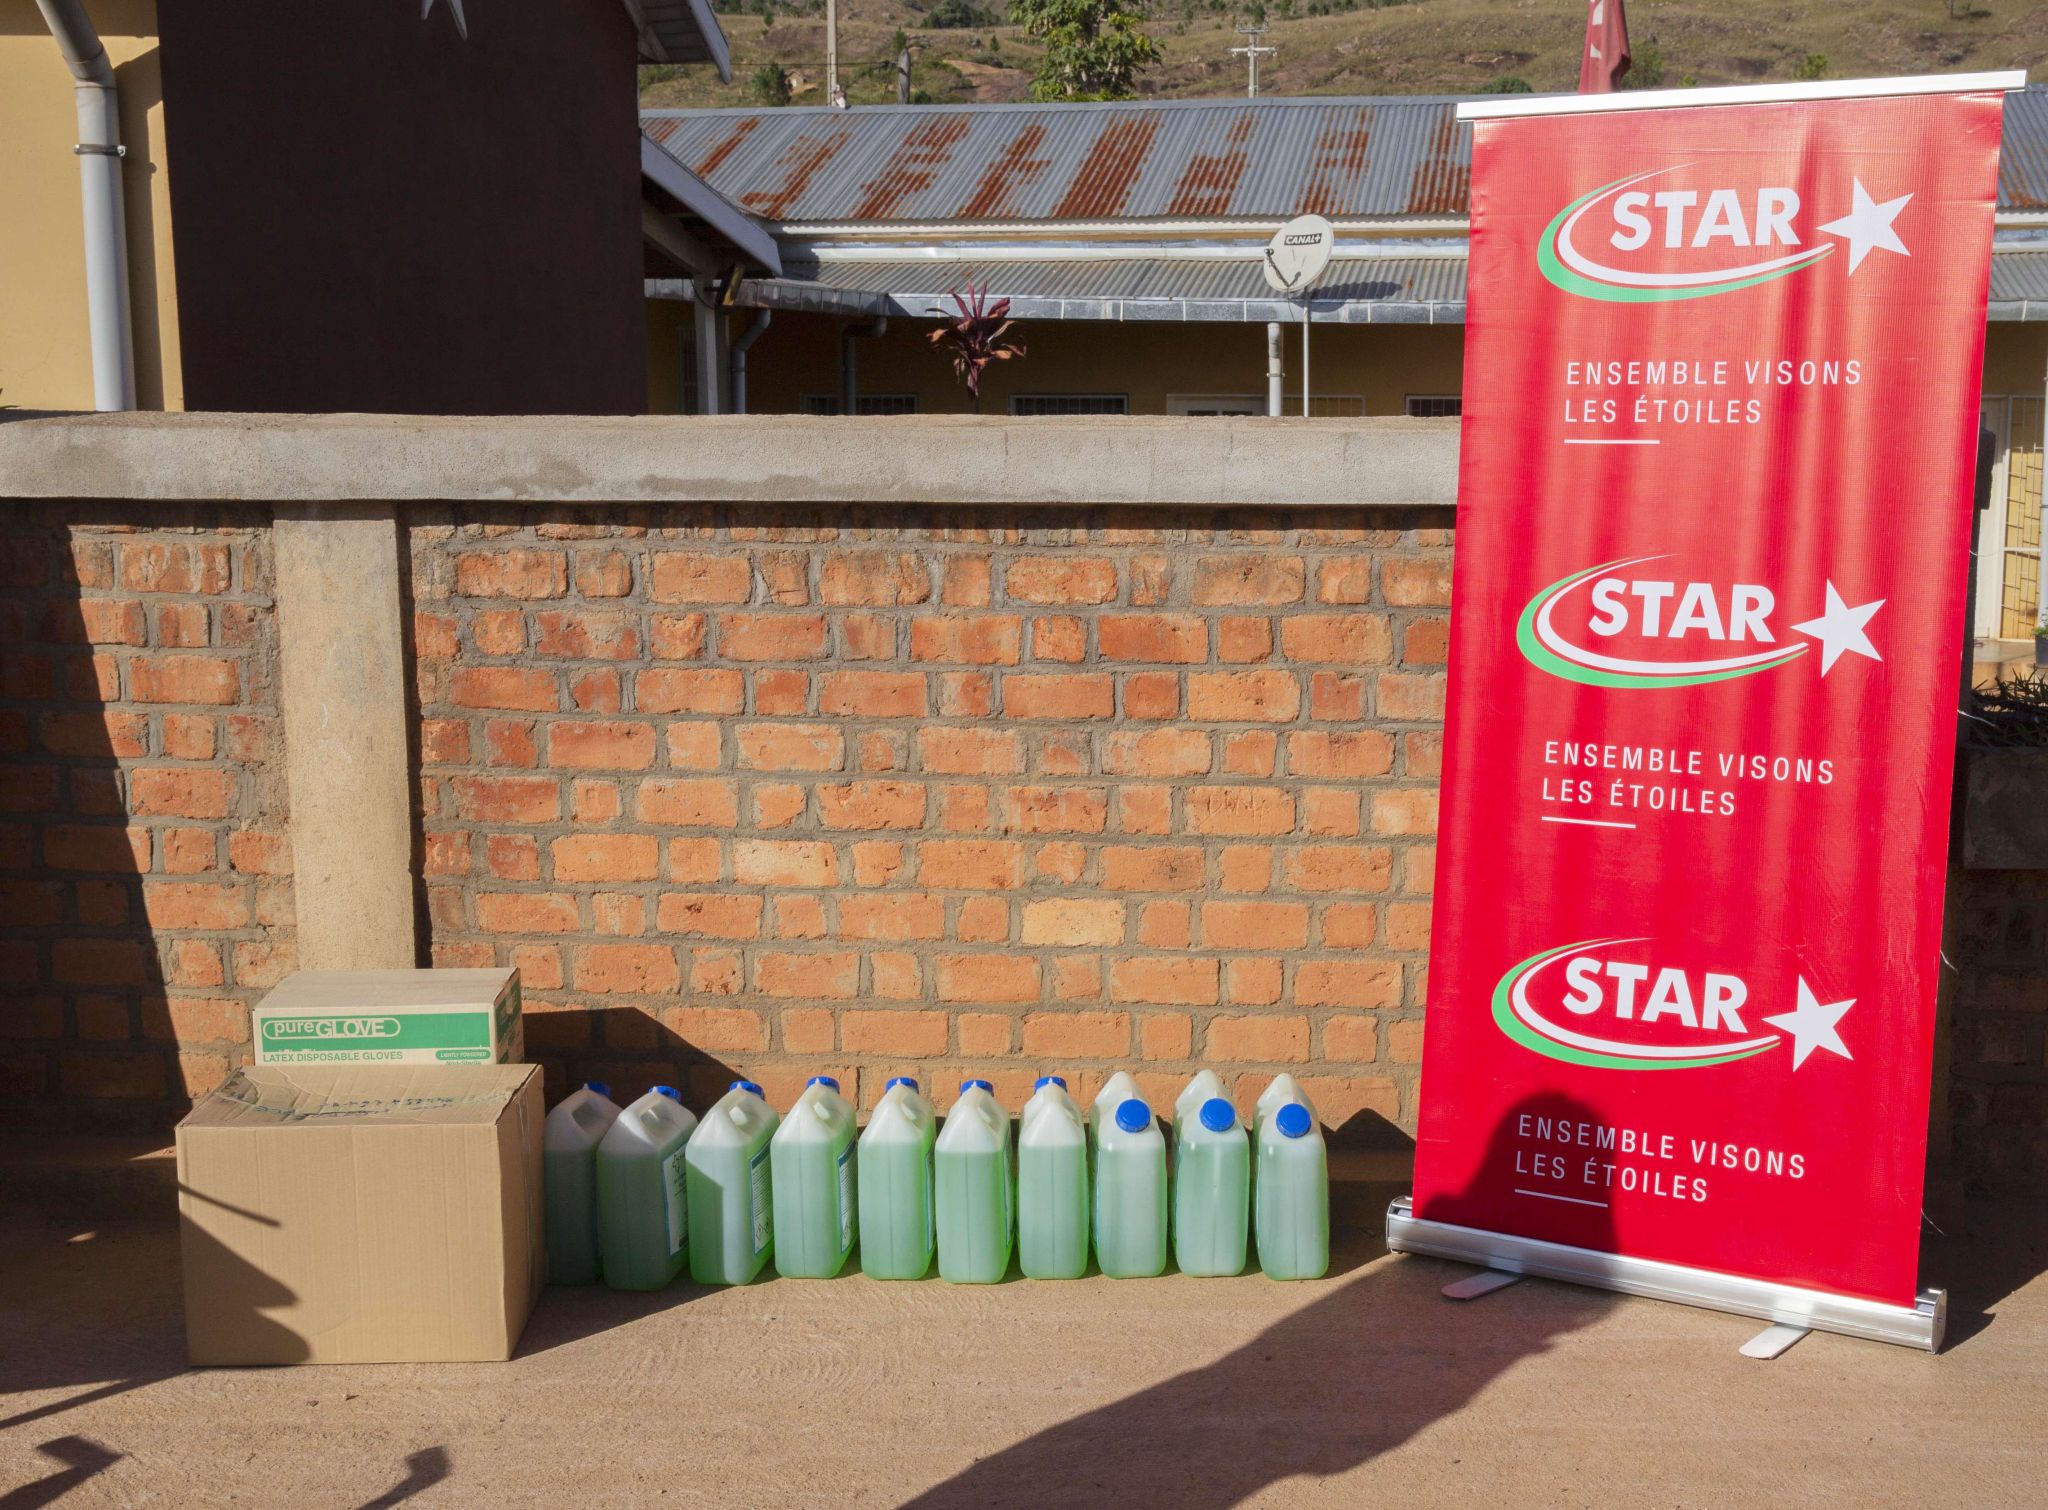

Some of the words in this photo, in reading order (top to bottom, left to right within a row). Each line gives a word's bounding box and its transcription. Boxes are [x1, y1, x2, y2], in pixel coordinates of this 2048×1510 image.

[1285, 234, 1321, 245] CANAL+
[1609, 186, 1801, 251] STAR
[1566, 361, 1727, 385] ENSEMBLE
[1745, 359, 1862, 385] VISONS
[1564, 399, 1616, 423] LES
[1634, 395, 1762, 424] ÉTOILES
[1588, 578, 1776, 643] STAR
[1545, 741, 1702, 775] ENSEMBLE
[1719, 753, 1834, 785] VISONS
[1542, 778, 1593, 804] LES
[1610, 779, 1735, 816] ÉTOILES
[1562, 957, 1748, 1033] STAR
[263, 1053, 294, 1062] LATEX
[297, 1052, 359, 1061] DISPOSABLE
[362, 1051, 403, 1060] GLOVES
[1518, 1114, 1675, 1160] ENSEMBLE
[1691, 1139, 1806, 1179] VISONS
[1516, 1150, 1566, 1180] LES
[1583, 1157, 1708, 1203] ÉTOILES
